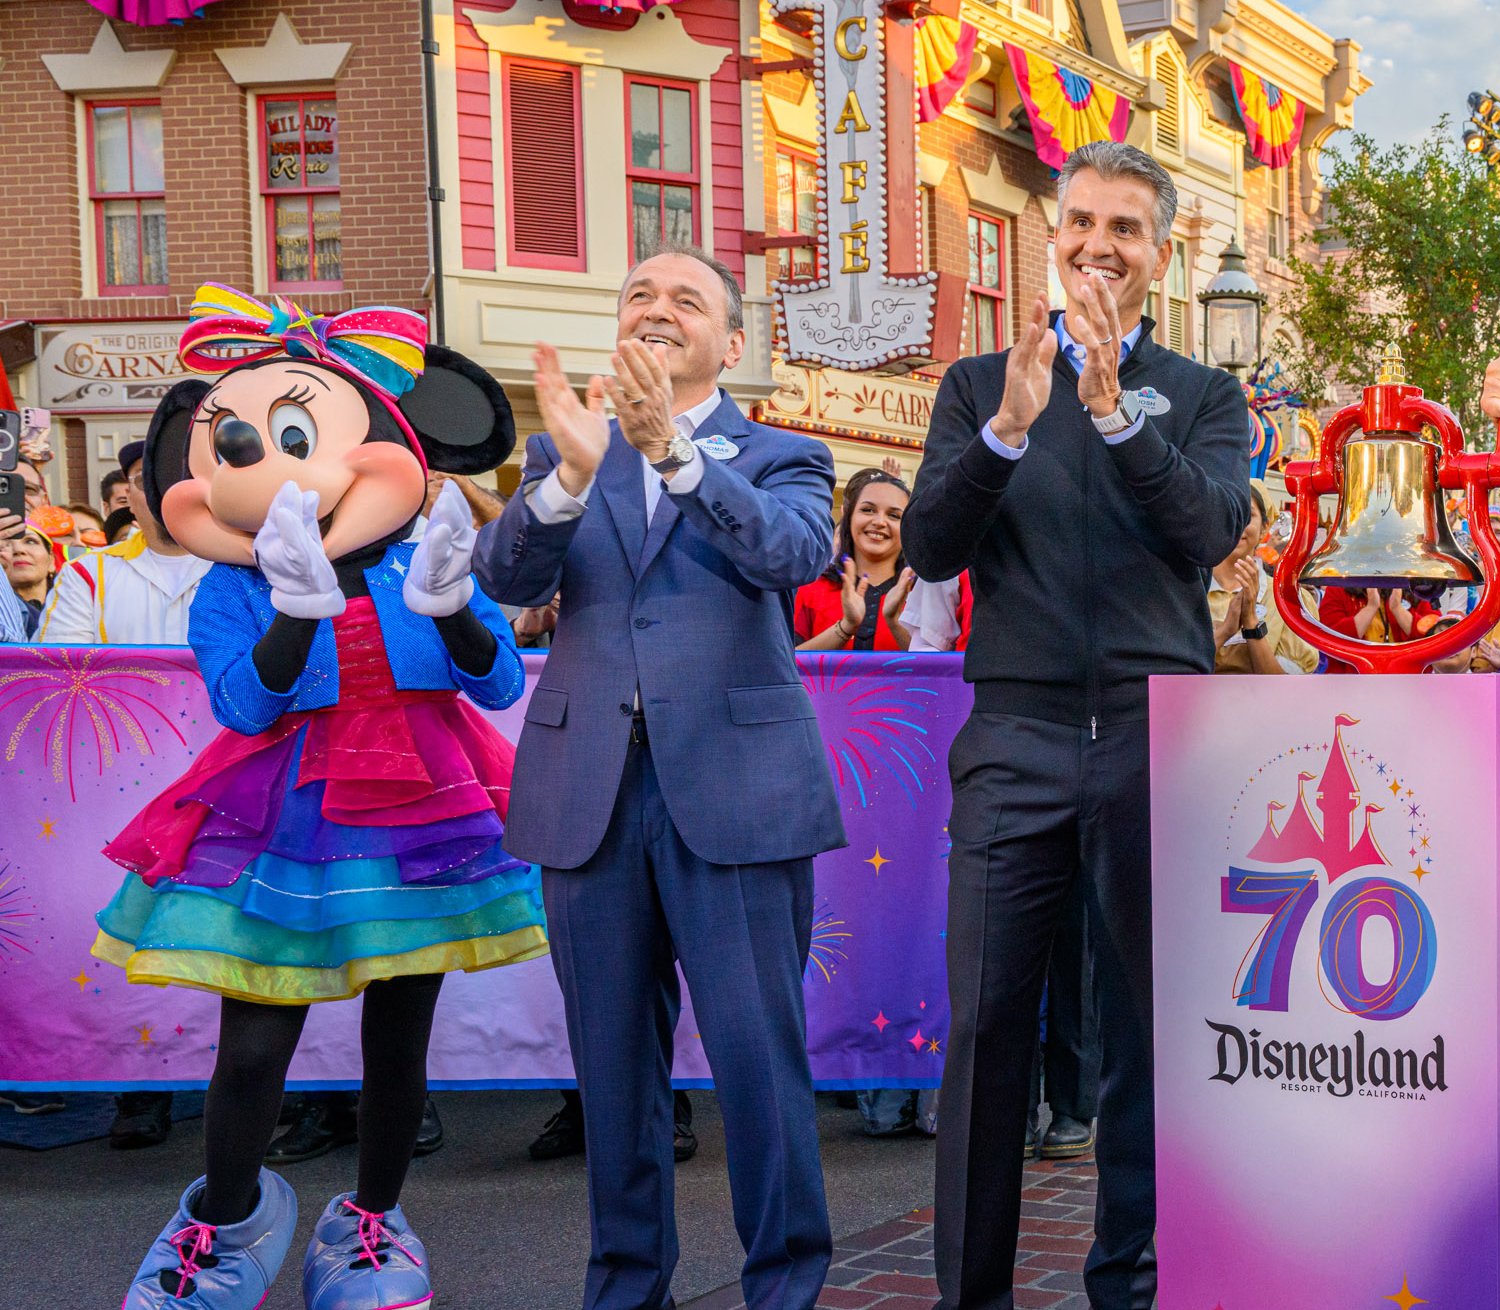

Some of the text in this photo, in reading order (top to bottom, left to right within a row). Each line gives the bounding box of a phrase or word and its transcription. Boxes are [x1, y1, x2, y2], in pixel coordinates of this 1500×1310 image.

[267, 114, 336, 136] MILADY
[834, 16, 871, 274] CAFÉ
[102, 335, 178, 350] THE ORIGIN
[1220, 866, 1438, 1021] 70
[1204, 1017, 1449, 1098] Disneyland
[1280, 1083, 1426, 1101] RESORT CALIFORNIA
